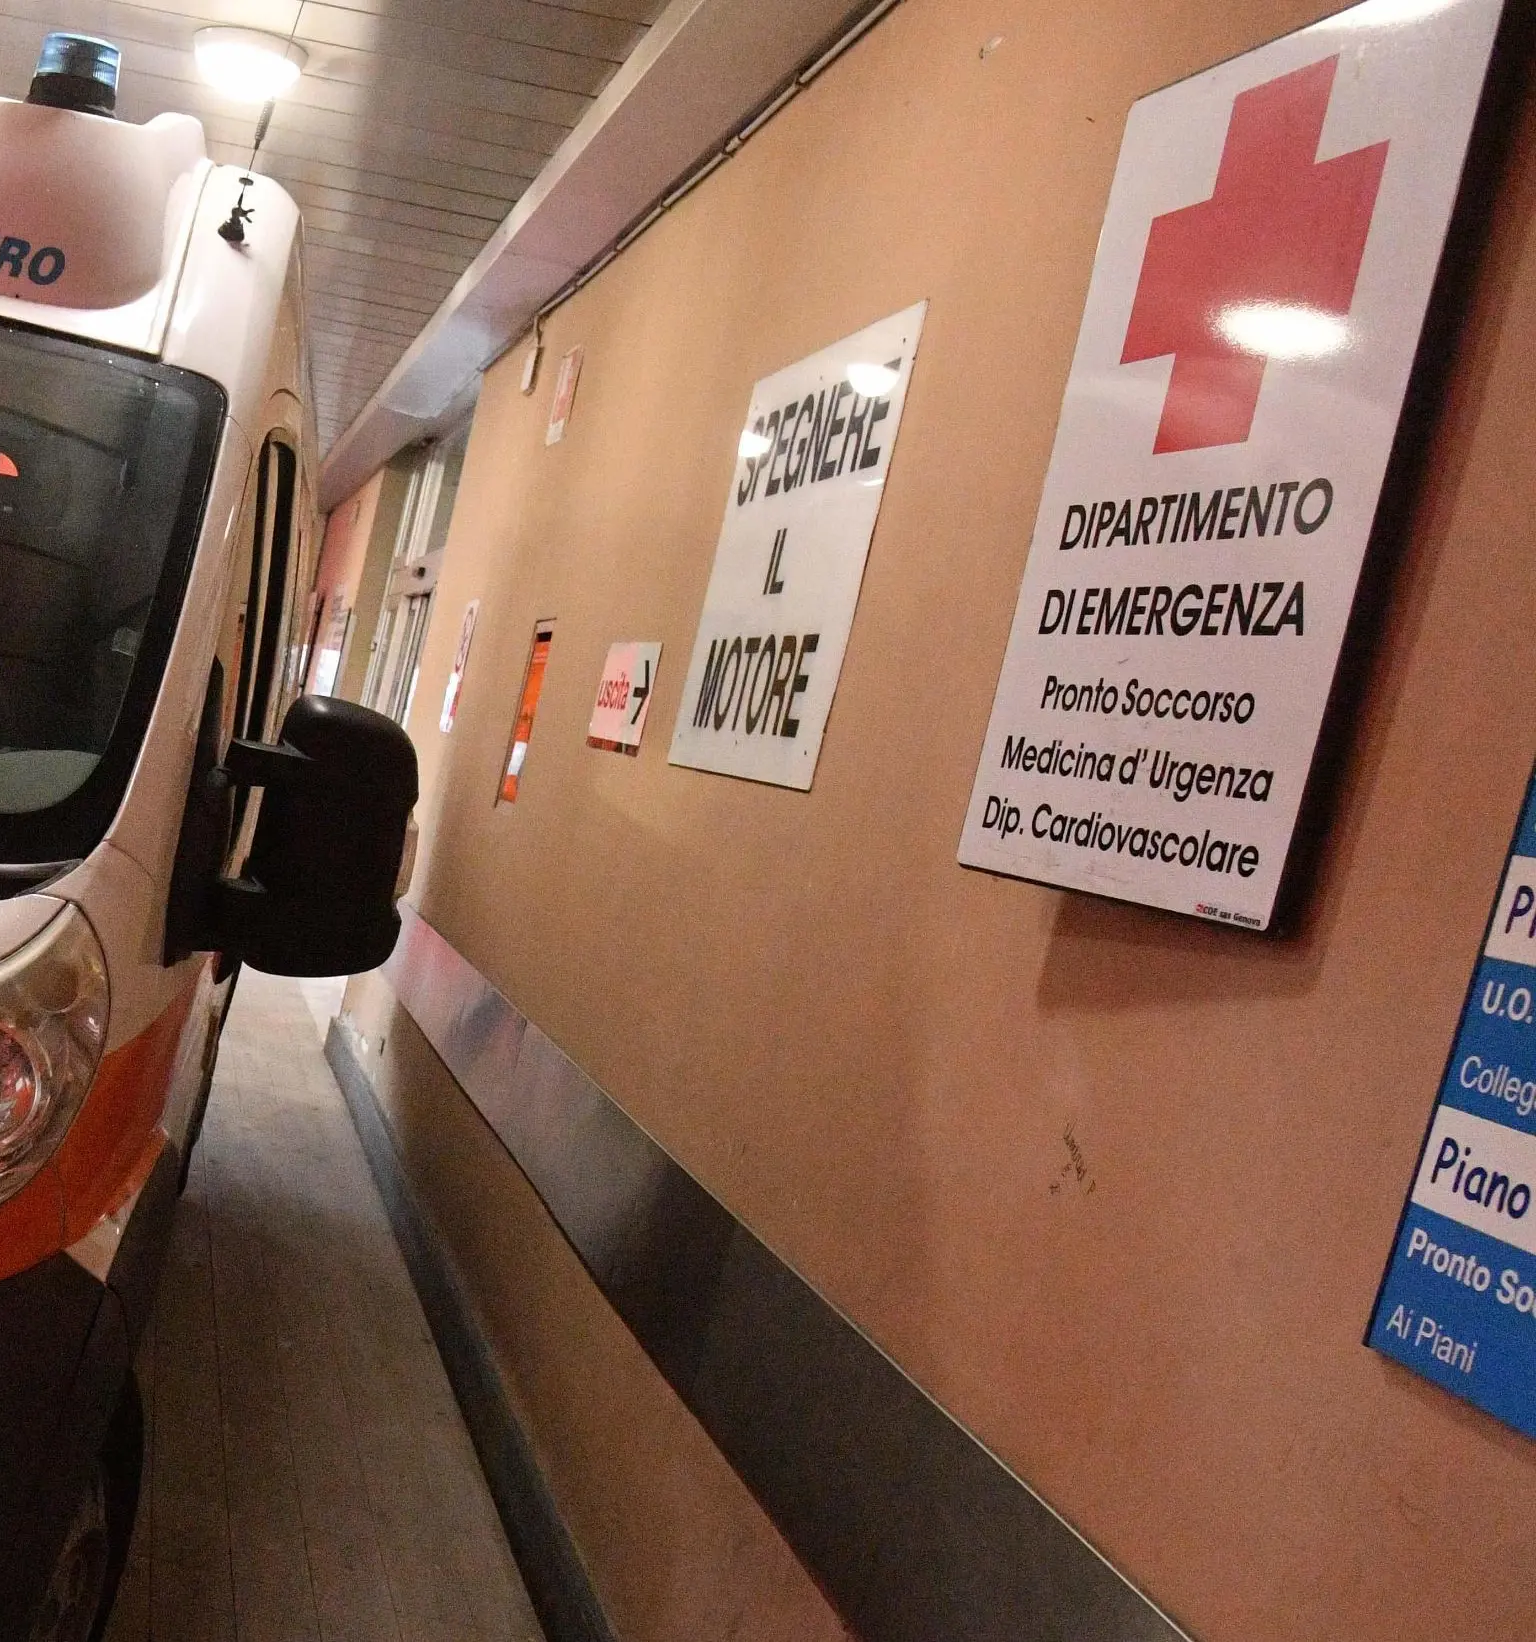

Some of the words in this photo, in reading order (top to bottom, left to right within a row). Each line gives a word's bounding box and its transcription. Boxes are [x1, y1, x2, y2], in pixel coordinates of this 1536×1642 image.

[737, 357, 902, 507] SPEGNERE
[1059, 478, 1334, 550] DIPARTIMENTO
[762, 527, 788, 596] IL
[1038, 588, 1077, 635] DI
[1076, 581, 1304, 637] EMERGENZA
[597, 671, 629, 710] uscita
[692, 633, 820, 739] MOTORE
[1041, 675, 1119, 715] Pronto
[1121, 678, 1256, 724] Soccorso
[1000, 735, 1116, 782] Medicina
[1149, 750, 1274, 802] Urgenza
[982, 795, 1024, 840] Dip.
[1031, 803, 1260, 878] Cardiovascolare
[1233, 912, 1261, 926] Genova
[1482, 980, 1533, 1024] U.O.
[1460, 1055, 1536, 1116] Colleg
[1430, 1137, 1531, 1219] Piano
[1407, 1228, 1490, 1292] Pronto
[1496, 1268, 1536, 1319] So
[1386, 1304, 1415, 1340] Ai
[1414, 1316, 1478, 1374] Piani
